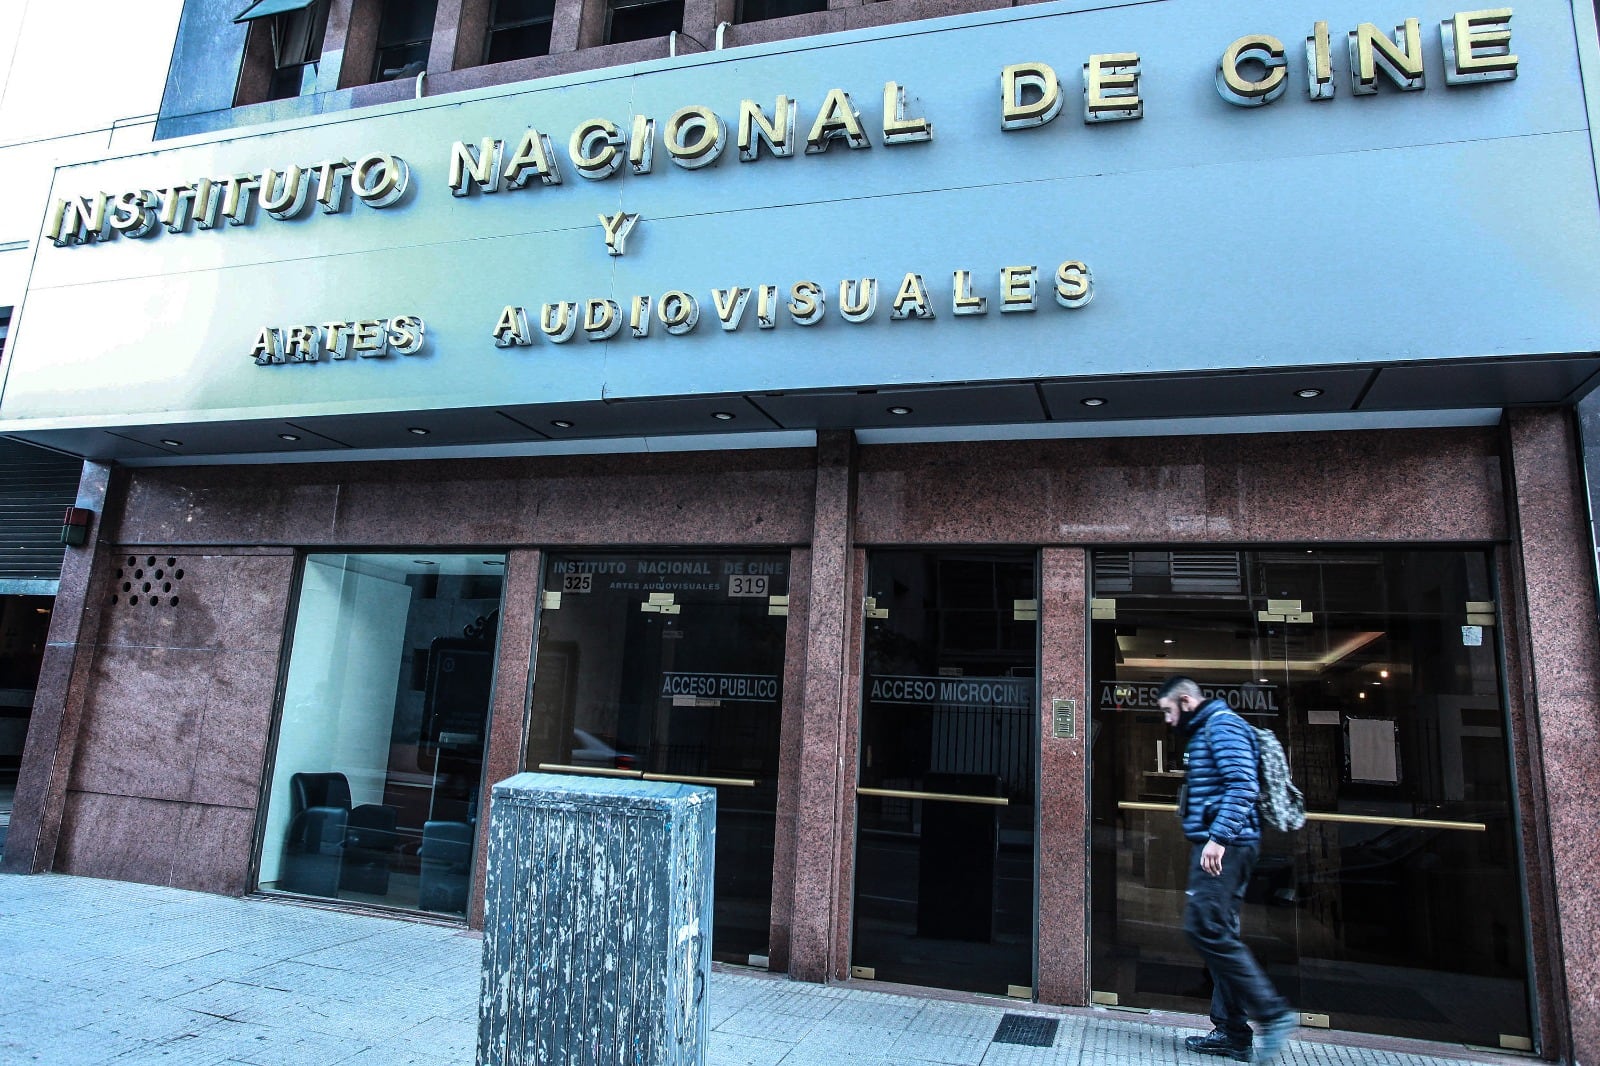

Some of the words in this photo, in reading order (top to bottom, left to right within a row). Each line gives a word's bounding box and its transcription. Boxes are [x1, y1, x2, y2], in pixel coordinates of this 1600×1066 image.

[46, 152, 410, 247] INSTITUTO
[448, 81, 933, 197] NACIONAL
[1000, 52, 1143, 131] DE
[1215, 9, 1518, 107] CINE
[599, 211, 640, 256] Y
[250, 315, 425, 366] ARTES
[494, 260, 1094, 347] AUDIOVISUALES
[553, 561, 627, 574] INSTITUTO
[638, 561, 711, 575] NACIONAL
[724, 562, 744, 575] DE
[748, 562, 785, 575] CINE
[565, 576, 590, 590] 325
[642, 582, 721, 591] AUDIOVISUALES
[732, 578, 766, 594] 319
[662, 676, 716, 695] ACCESO
[719, 678, 778, 698] PUBLICO
[871, 680, 936, 700] ACCESO
[940, 682, 1030, 703] MICROCINE
[1100, 685, 1160, 707] ACCES
